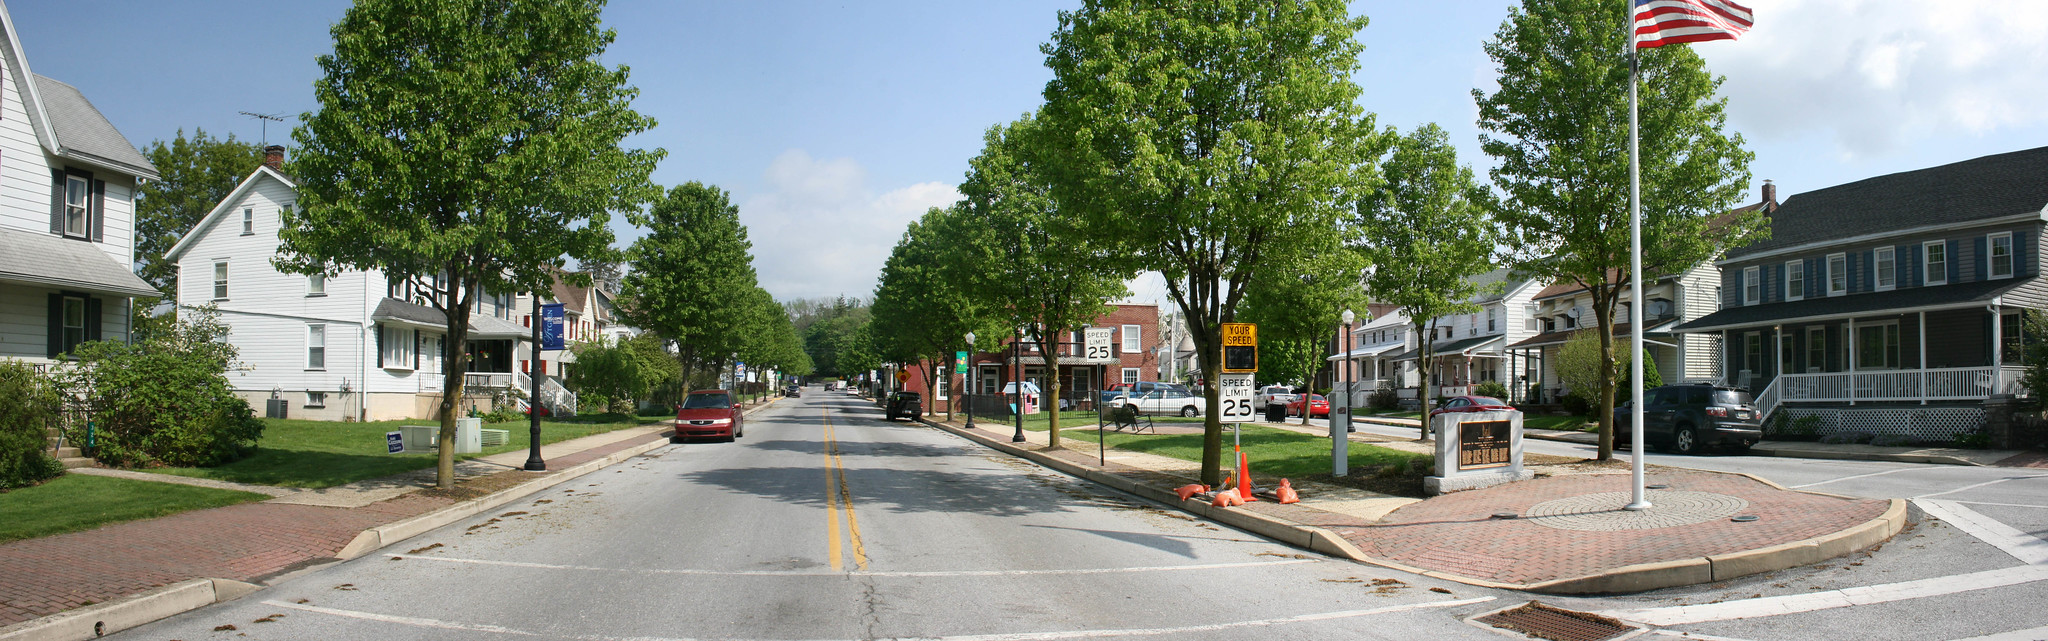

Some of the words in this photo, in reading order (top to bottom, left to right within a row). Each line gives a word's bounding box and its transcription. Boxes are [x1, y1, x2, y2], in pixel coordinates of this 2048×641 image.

[1229, 326, 1250, 334] YOUR
[1228, 336, 1252, 344] SPEED
[1088, 346, 1109, 359] 25
[1222, 379, 1252, 387] SPEED
[1225, 389, 1248, 397] LIMIT
[1223, 399, 1252, 417] 25
